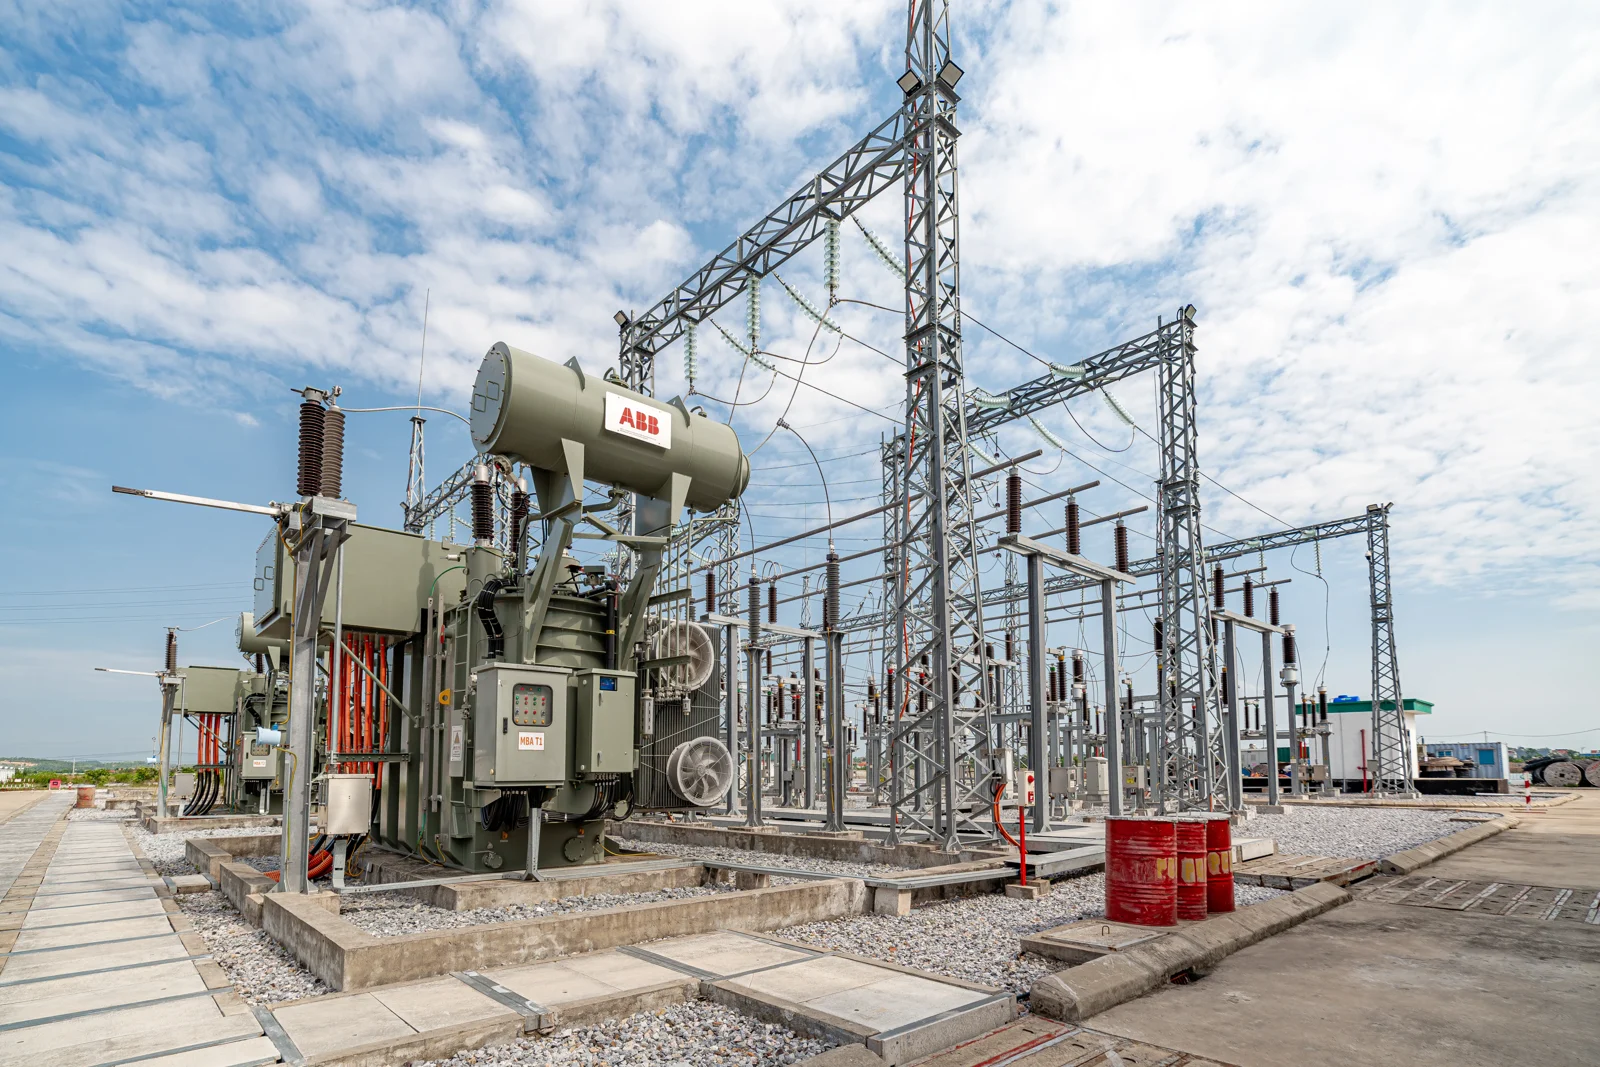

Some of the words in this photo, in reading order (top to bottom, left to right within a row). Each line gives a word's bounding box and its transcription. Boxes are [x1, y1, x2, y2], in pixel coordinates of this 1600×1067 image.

[619, 407, 660, 435] ABB
[520, 736, 534, 746] MBA
[535, 736, 543, 746] T1
